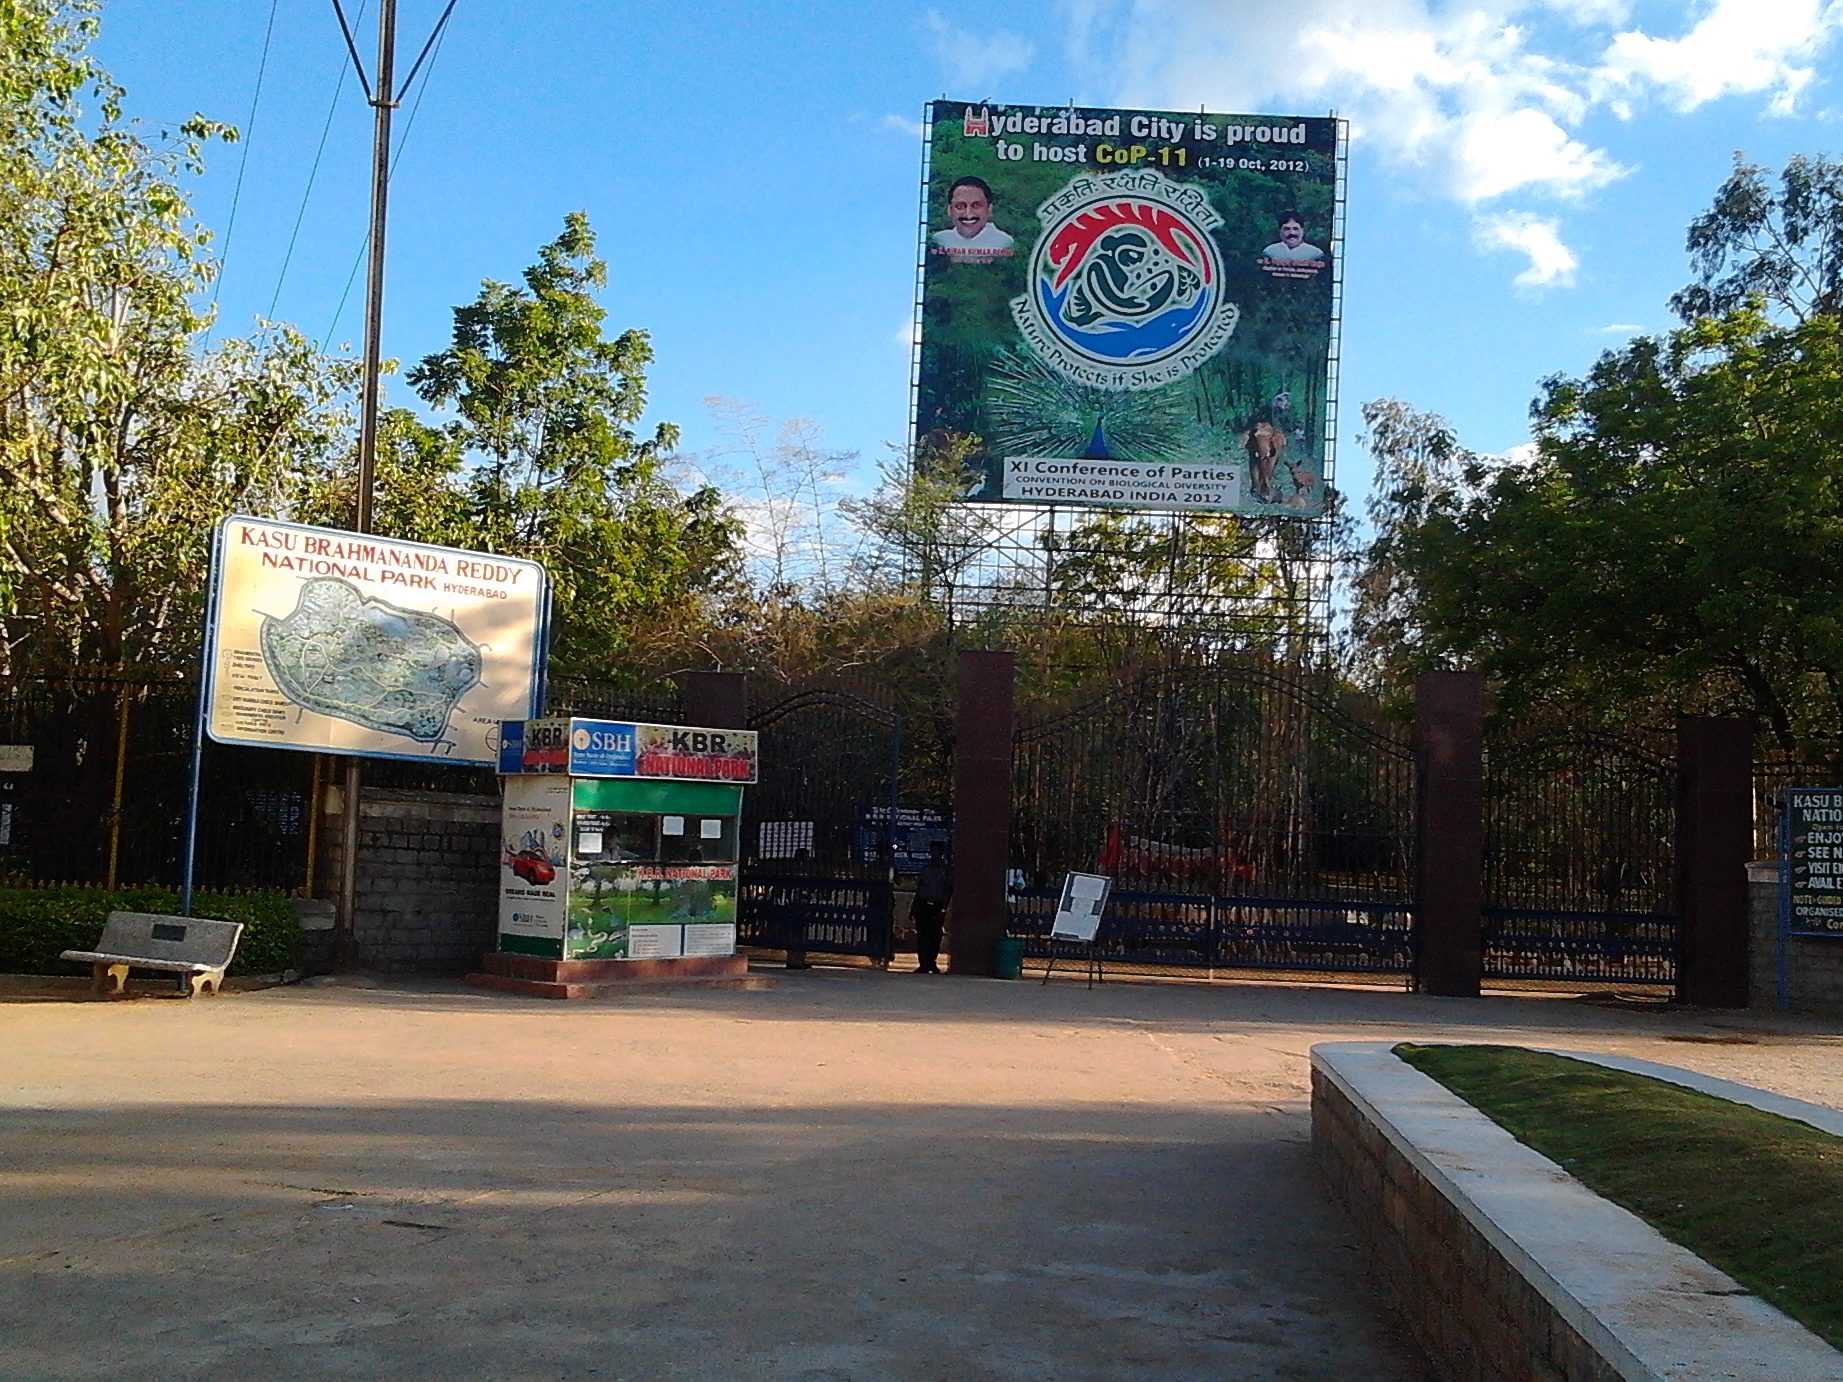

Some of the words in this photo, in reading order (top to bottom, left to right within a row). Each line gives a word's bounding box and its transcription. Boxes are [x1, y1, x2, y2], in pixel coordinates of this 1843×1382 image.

[1130, 117, 1185, 143] City
[1195, 119, 1217, 140] is
[1227, 123, 1306, 145] proud
[996, 140, 1023, 160] to
[1033, 142, 1087, 162] host
[1096, 144, 1187, 166] CoP-11
[1197, 156, 1235, 169] (1-19
[1269, 160, 1310, 172] 2012)
[1015, 298, 1051, 352] Nature
[1050, 349, 1108, 385] Protects
[1112, 371, 1126, 386] if
[1130, 371, 1162, 386] She
[1166, 367, 1180, 379] is
[1180, 307, 1235, 369] Protected
[1010, 460, 1028, 472] XI
[1035, 461, 1140, 478] Conference
[1146, 465, 1164, 478] of
[1171, 467, 1235, 481] Parties
[1015, 476, 1087, 485] CONVENTION
[1109, 479, 1170, 489] BIOLOGICAL
[1174, 481, 1227, 491] DIVERSITY
[1021, 486, 1124, 500] HYDERABAD
[1130, 489, 1178, 502] INDIA
[1183, 493, 1222, 504] 2012
[241, 526, 298, 551] KASU
[304, 536, 449, 575] BRAHMANANDA
[456, 559, 523, 585] REDDY
[262, 552, 376, 581] NATIONAL
[380, 570, 438, 591] PARK
[443, 582, 508, 600] HYDERABAD
[592, 732, 632, 753] SBH
[672, 731, 727, 753] KBR
[645, 754, 711, 776] NATIONAL
[713, 757, 750, 779] PARK
[1793, 795, 1829, 808] KASU
[1807, 846, 1830, 858] SEE
[1808, 862, 1830, 874] VISIT
[1808, 877, 1835, 889] AVAIL
